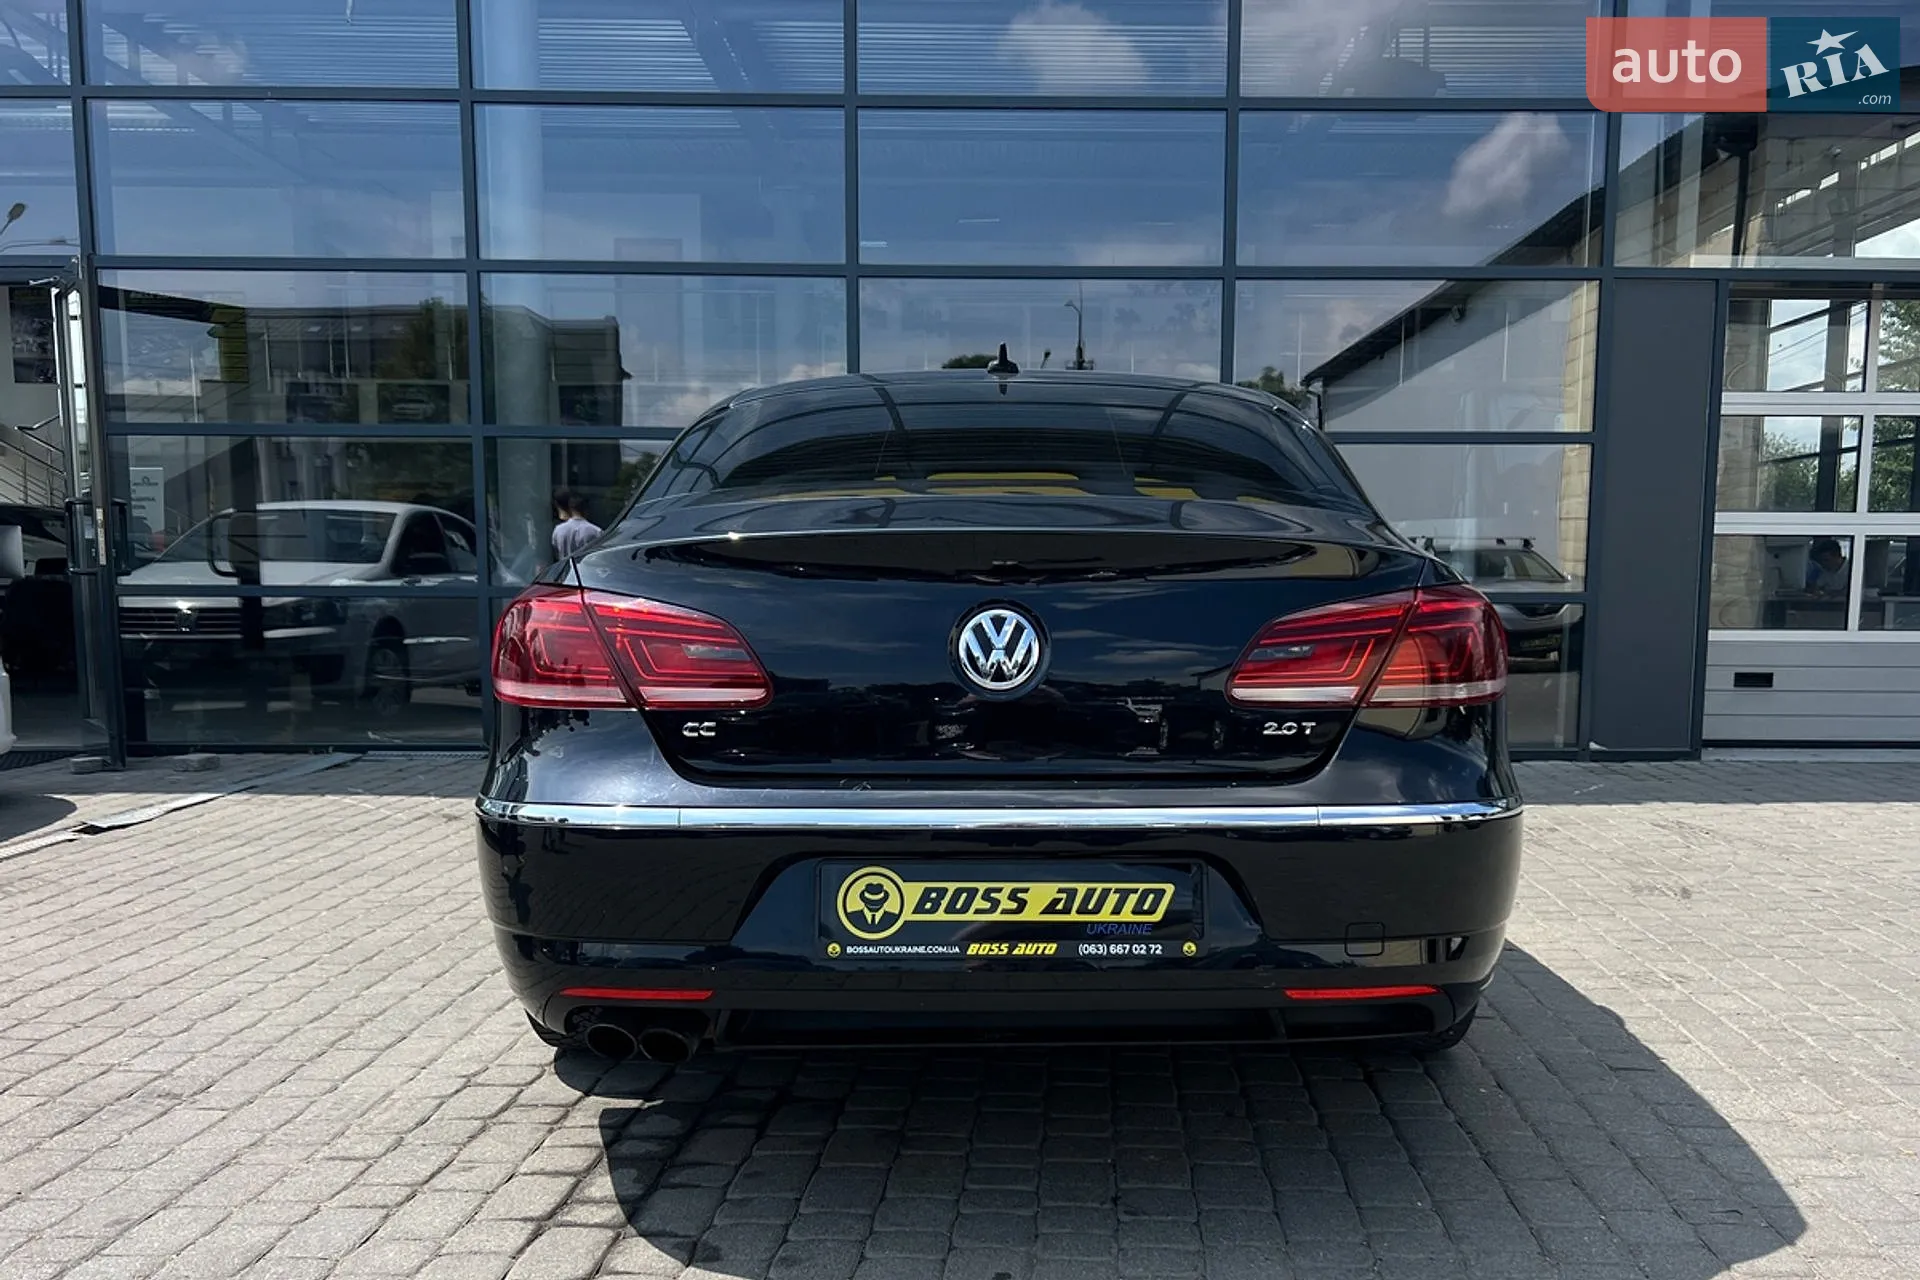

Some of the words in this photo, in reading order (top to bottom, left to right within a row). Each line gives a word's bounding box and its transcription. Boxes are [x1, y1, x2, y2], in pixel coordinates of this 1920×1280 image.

[682, 721, 717, 737] CC
[911, 886, 1031, 915] BOSS
[1039, 887, 1167, 916] AUTO
[1086, 923, 1153, 936] UKRAINE
[846, 944, 960, 955] BOSSAUTOUKRAINE.COM.UA
[966, 943, 1010, 955] BOSS
[1011, 943, 1058, 955] AUTO
[1078, 943, 1107, 956] (063)
[1110, 943, 1130, 955] 667
[1132, 943, 1147, 955] 02
[1149, 943, 1163, 955] 72
